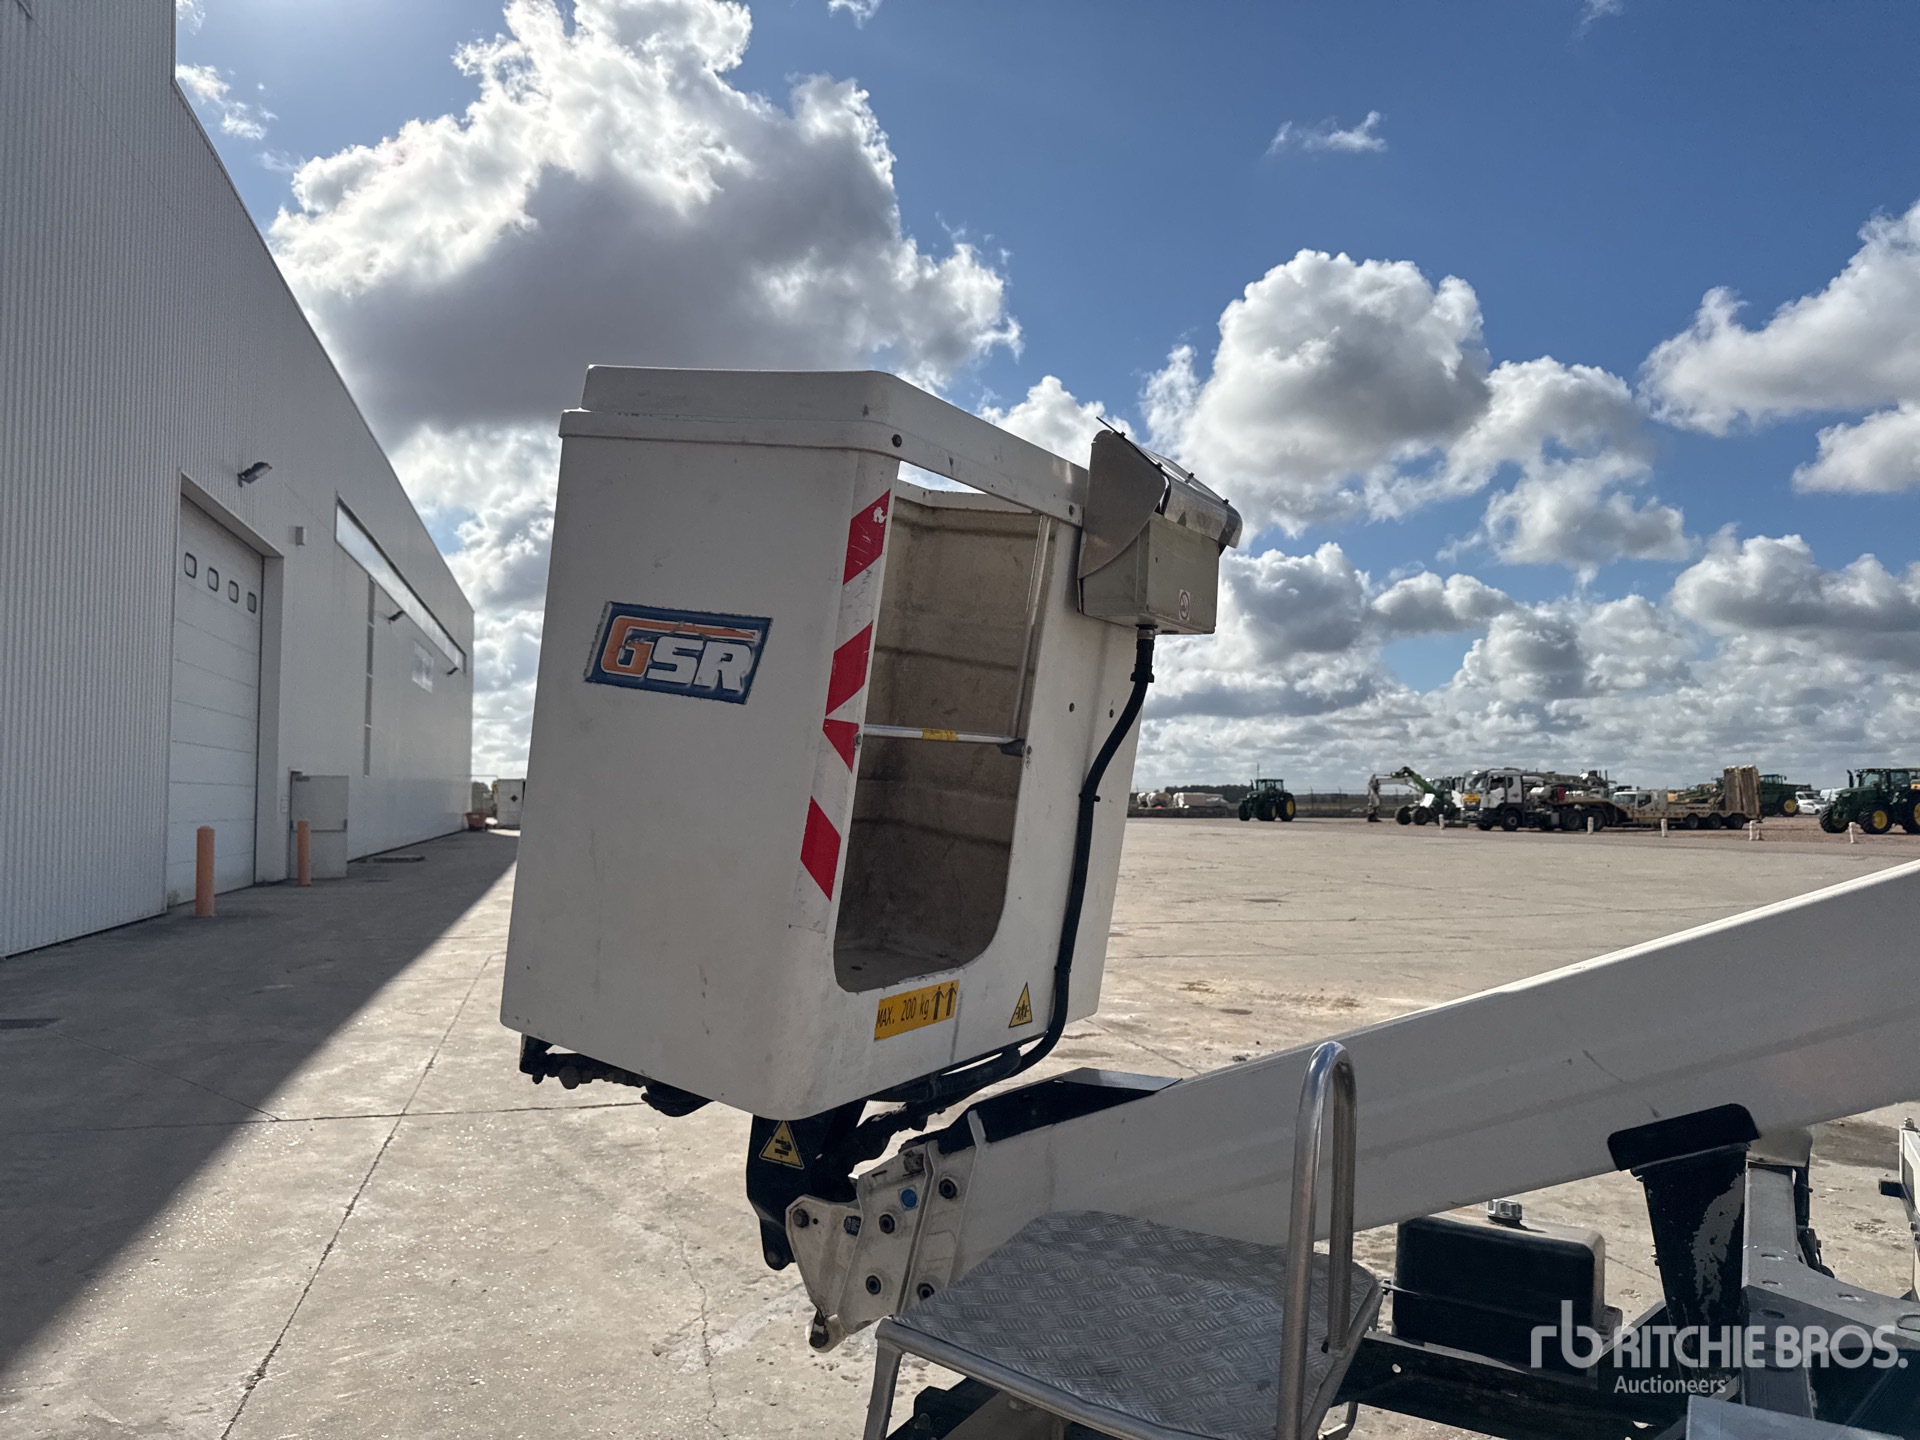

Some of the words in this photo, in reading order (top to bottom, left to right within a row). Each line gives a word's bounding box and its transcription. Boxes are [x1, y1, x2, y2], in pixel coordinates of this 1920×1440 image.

[601, 615, 759, 692] GSR
[876, 1006, 895, 1029] MAX.
[901, 997, 917, 1022] 200
[919, 994, 930, 1021] kg
